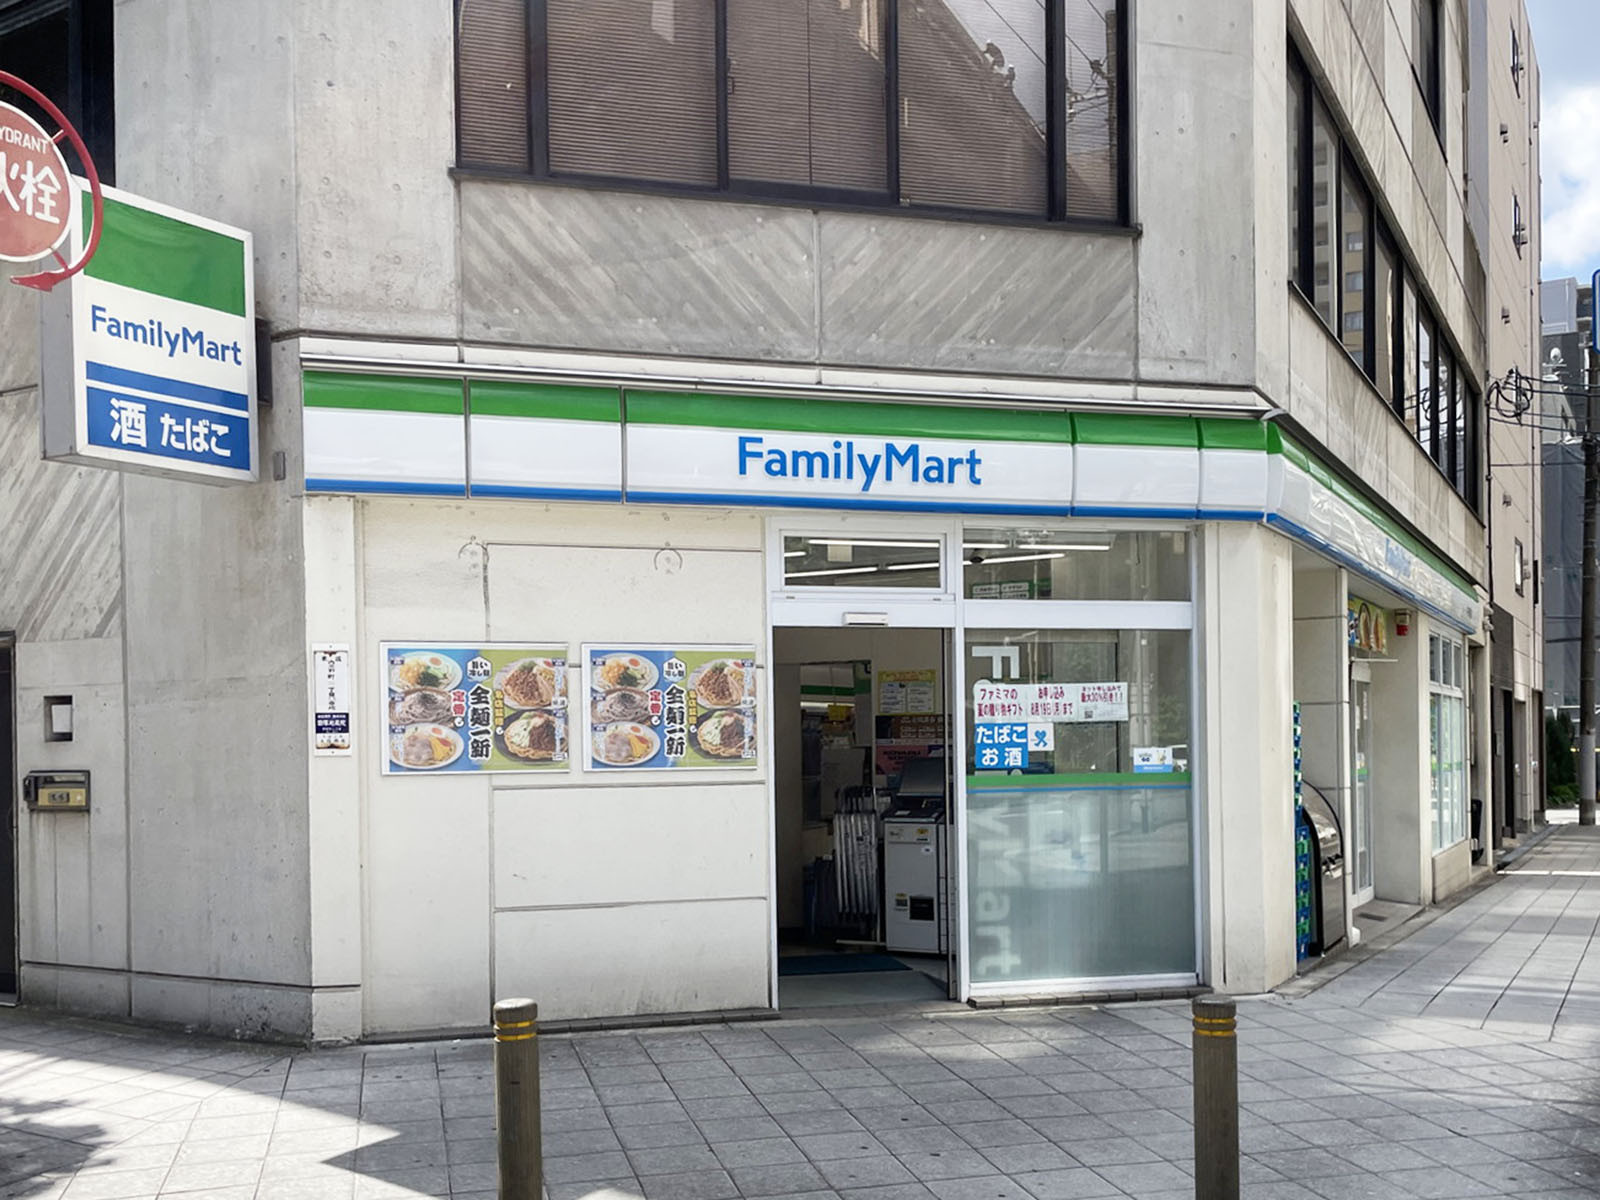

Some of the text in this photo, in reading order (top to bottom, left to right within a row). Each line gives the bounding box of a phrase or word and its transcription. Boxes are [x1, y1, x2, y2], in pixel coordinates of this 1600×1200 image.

[91, 304, 242, 366] FamilyMart
[110, 397, 231, 457] 酒 たばこ
[738, 436, 982, 492] FamilyMart
[471, 660, 488, 669] い
[980, 688, 1018, 700] ファミマの
[976, 725, 1026, 744] たばこ
[982, 747, 1022, 766] お酒
